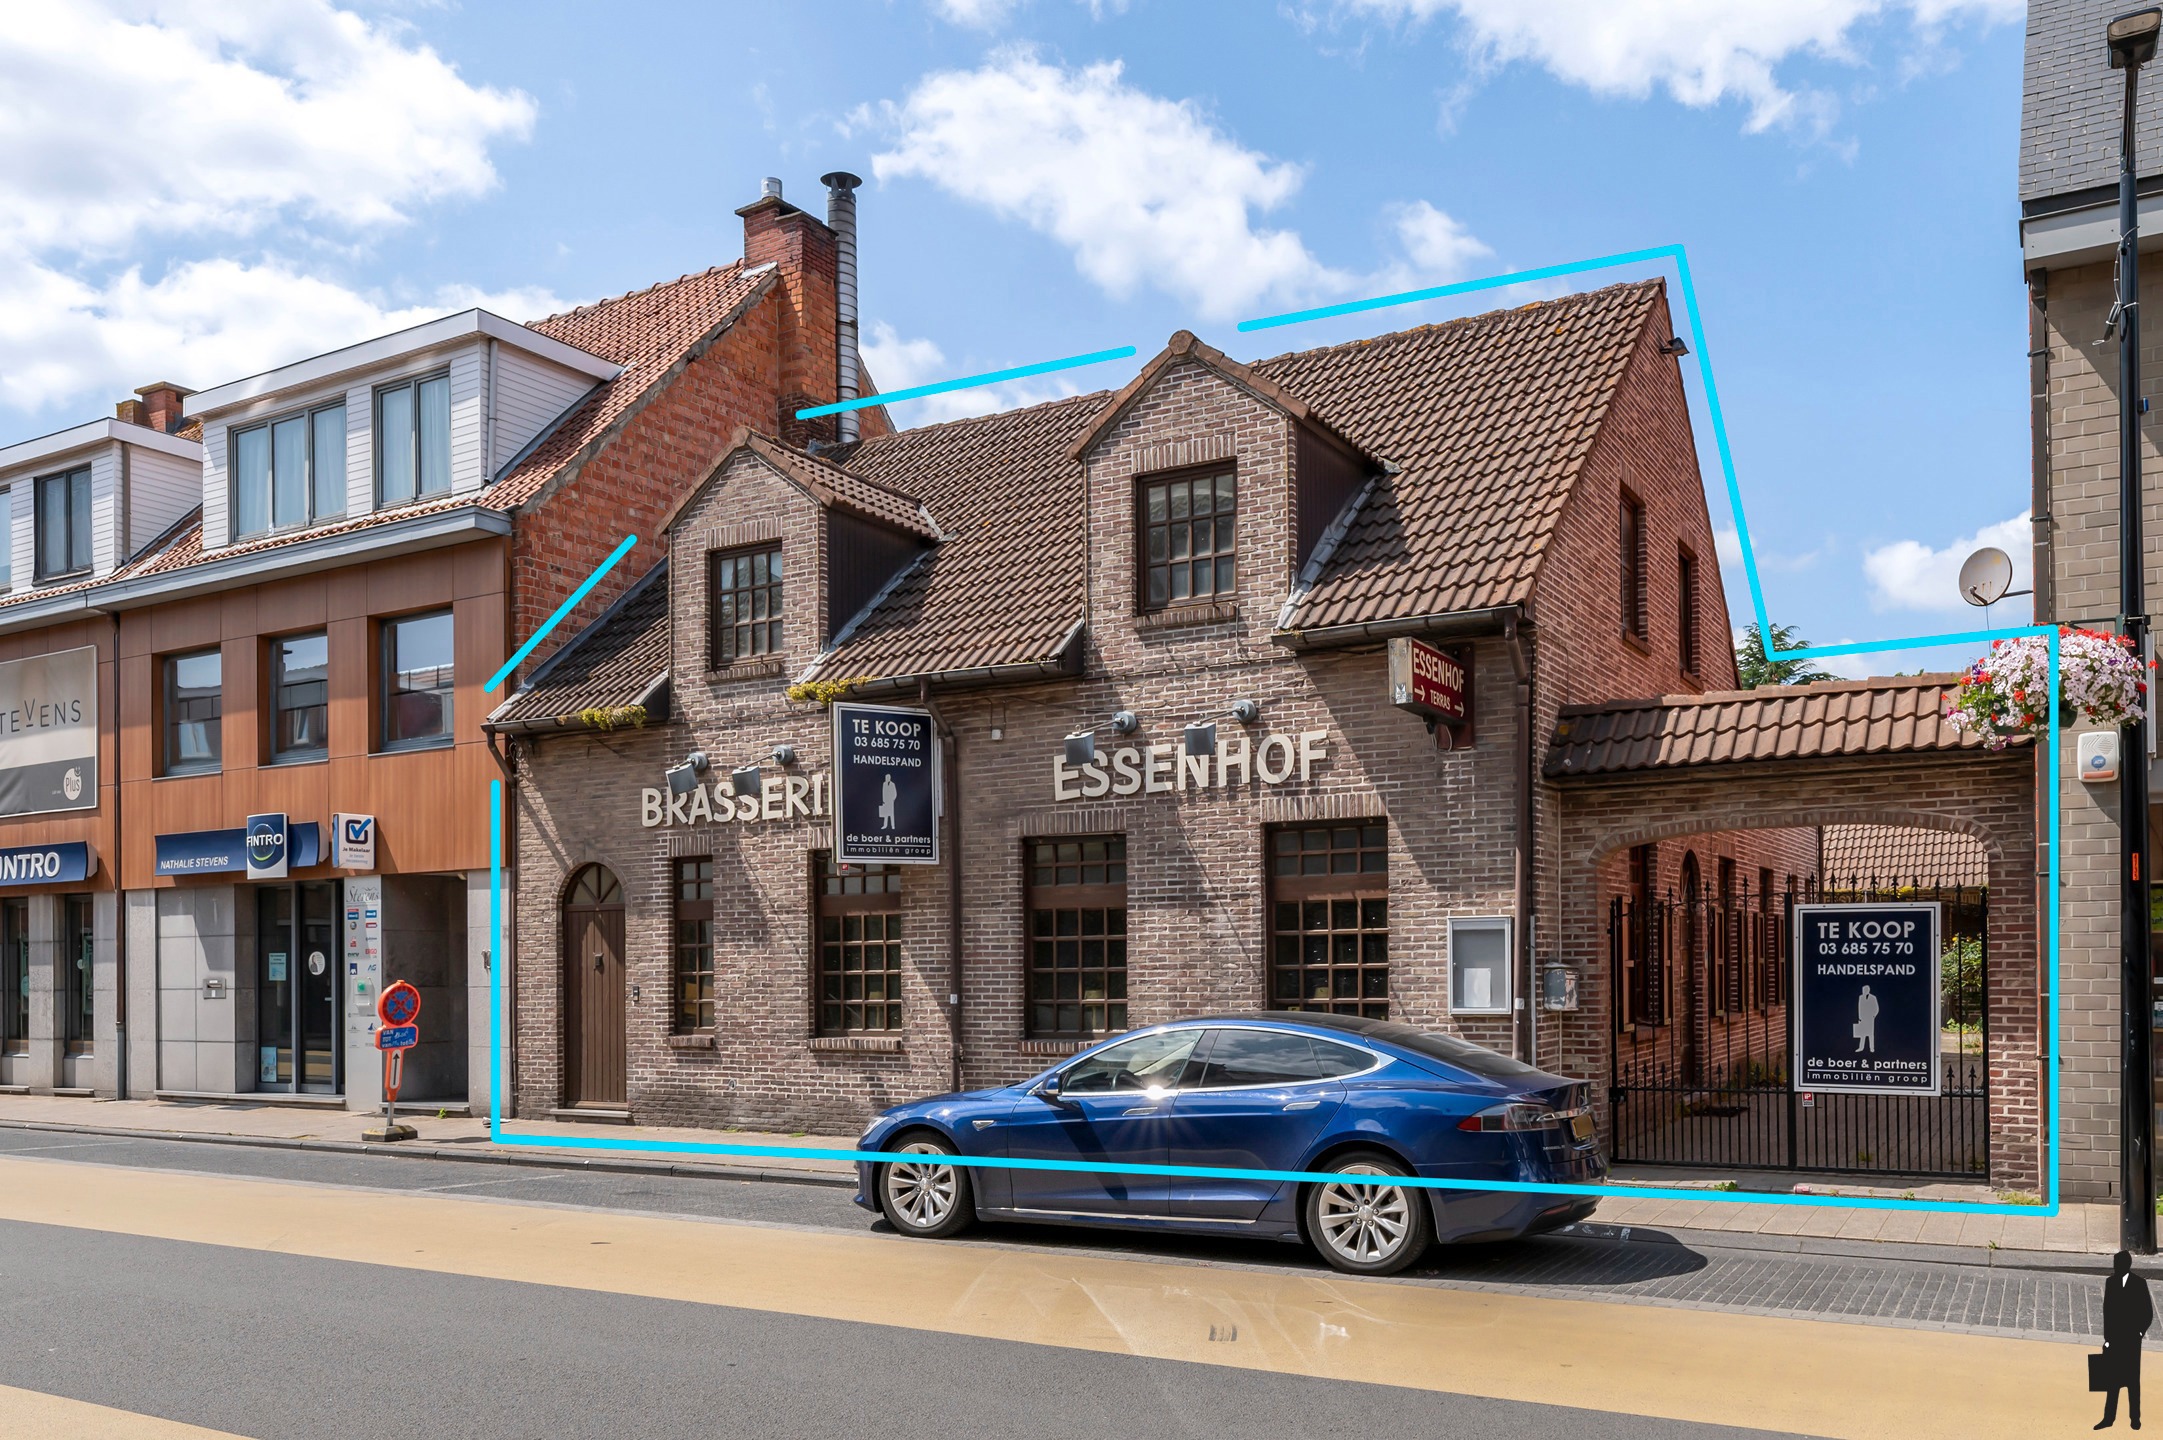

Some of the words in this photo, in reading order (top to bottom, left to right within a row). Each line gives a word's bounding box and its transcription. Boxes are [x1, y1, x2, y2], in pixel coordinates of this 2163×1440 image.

[1413, 647, 1465, 693] ESSENHOF
[1429, 689, 1451, 710] TERRAS
[852, 719, 870, 734] TE
[875, 720, 922, 737] KOOP
[854, 736, 868, 747] 03
[871, 737, 890, 748] 685
[892, 739, 905, 749] 75
[908, 740, 921, 751] 70
[853, 754, 922, 768] HANDELSPAND
[1054, 730, 1327, 801] ESSENHOF
[65, 777, 80, 793] Plus
[641, 773, 832, 828] BRASSERI
[246, 833, 284, 848] FINTRO
[846, 833, 859, 843] de
[861, 834, 883, 844] boer
[885, 834, 892, 843] &
[894, 834, 931, 845] partners
[160, 858, 194, 870] NATHALIE
[195, 856, 229, 868] STEVENS
[1817, 922, 1840, 939] TE
[1848, 921, 1915, 939] KOOP
[1819, 942, 1837, 955] 03
[1841, 942, 1868, 955] 685
[1872, 942, 1890, 955] 75
[1895, 942, 1914, 955] 70
[1817, 964, 1916, 976] HANDELSPAND
[1807, 1057, 1824, 1068] de
[1828, 1057, 1857, 1068] boer
[1861, 1059, 1869, 1069] &
[1874, 1058, 1928, 1072] partners
[1807, 1072, 1880, 1082] immobiliën
[1888, 1074, 1928, 1084] groep
